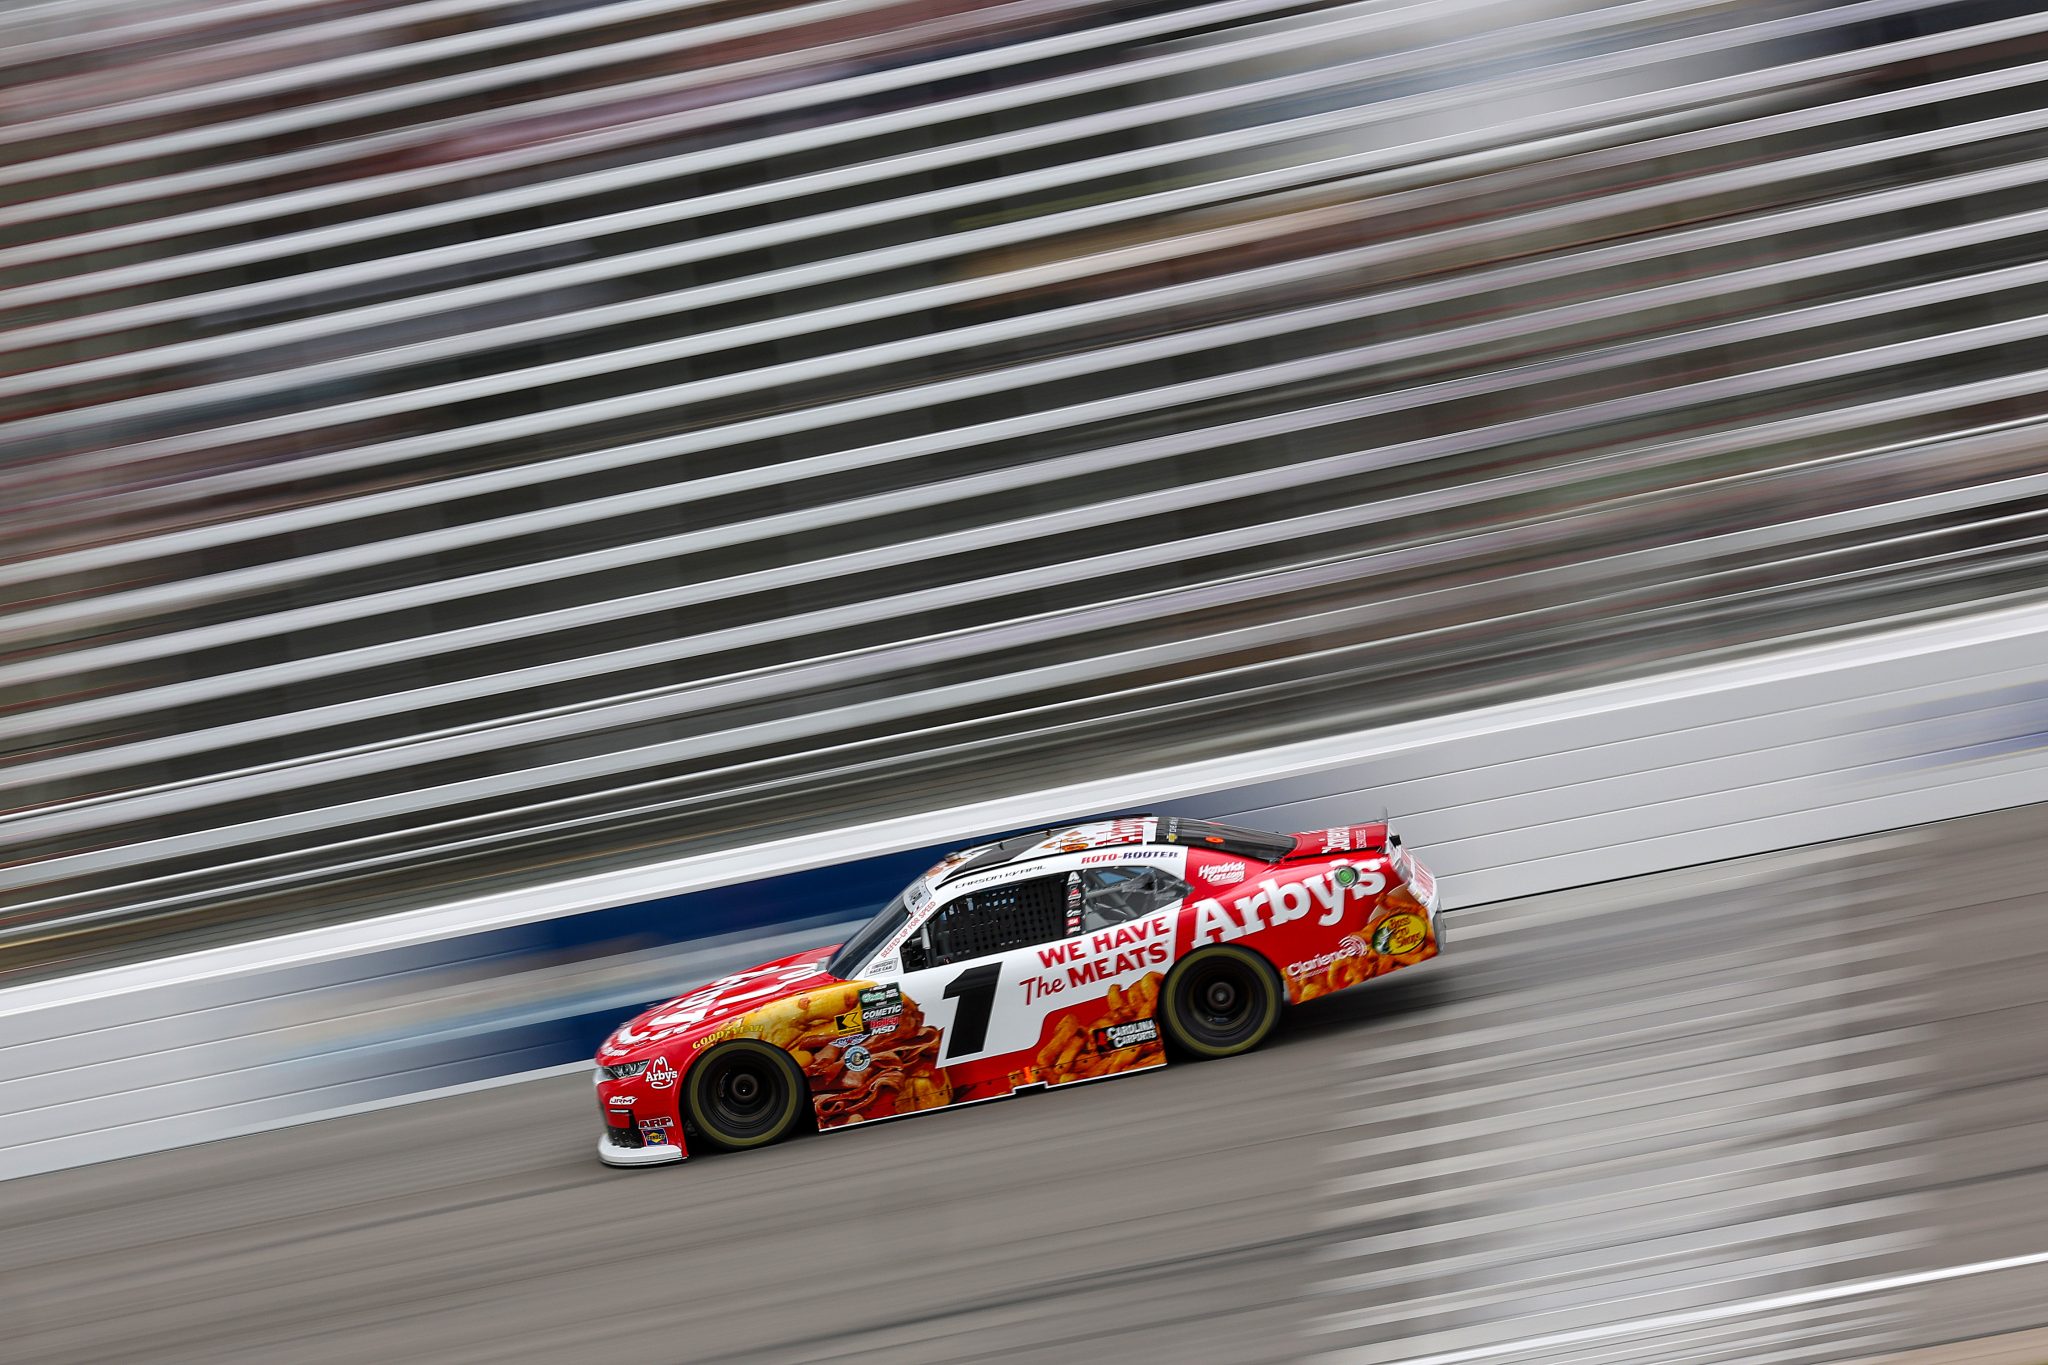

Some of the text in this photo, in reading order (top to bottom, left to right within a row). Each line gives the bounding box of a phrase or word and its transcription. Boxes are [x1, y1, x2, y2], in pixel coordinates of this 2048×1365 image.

[1081, 851, 1179, 864] ROTO-ROOTER
[1198, 862, 1245, 879] Hendrick
[955, 875, 1003, 889] CARSON
[1191, 857, 1388, 949] Arby's
[880, 901, 937, 958] BEEFED-UP FOR SPEED
[1037, 916, 1171, 969] WE HAVE
[1286, 944, 1358, 977] Clarience
[1018, 941, 1169, 1006] The MEATS
[863, 1004, 902, 1020] COMETIC
[943, 961, 1003, 1060] 1
[692, 1024, 764, 1049] GOODYEAR
[871, 1025, 896, 1035] MSD
[1106, 1020, 1156, 1039] CAROLINA
[645, 1067, 678, 1089] Arby's
[639, 1117, 672, 1128] ARP
